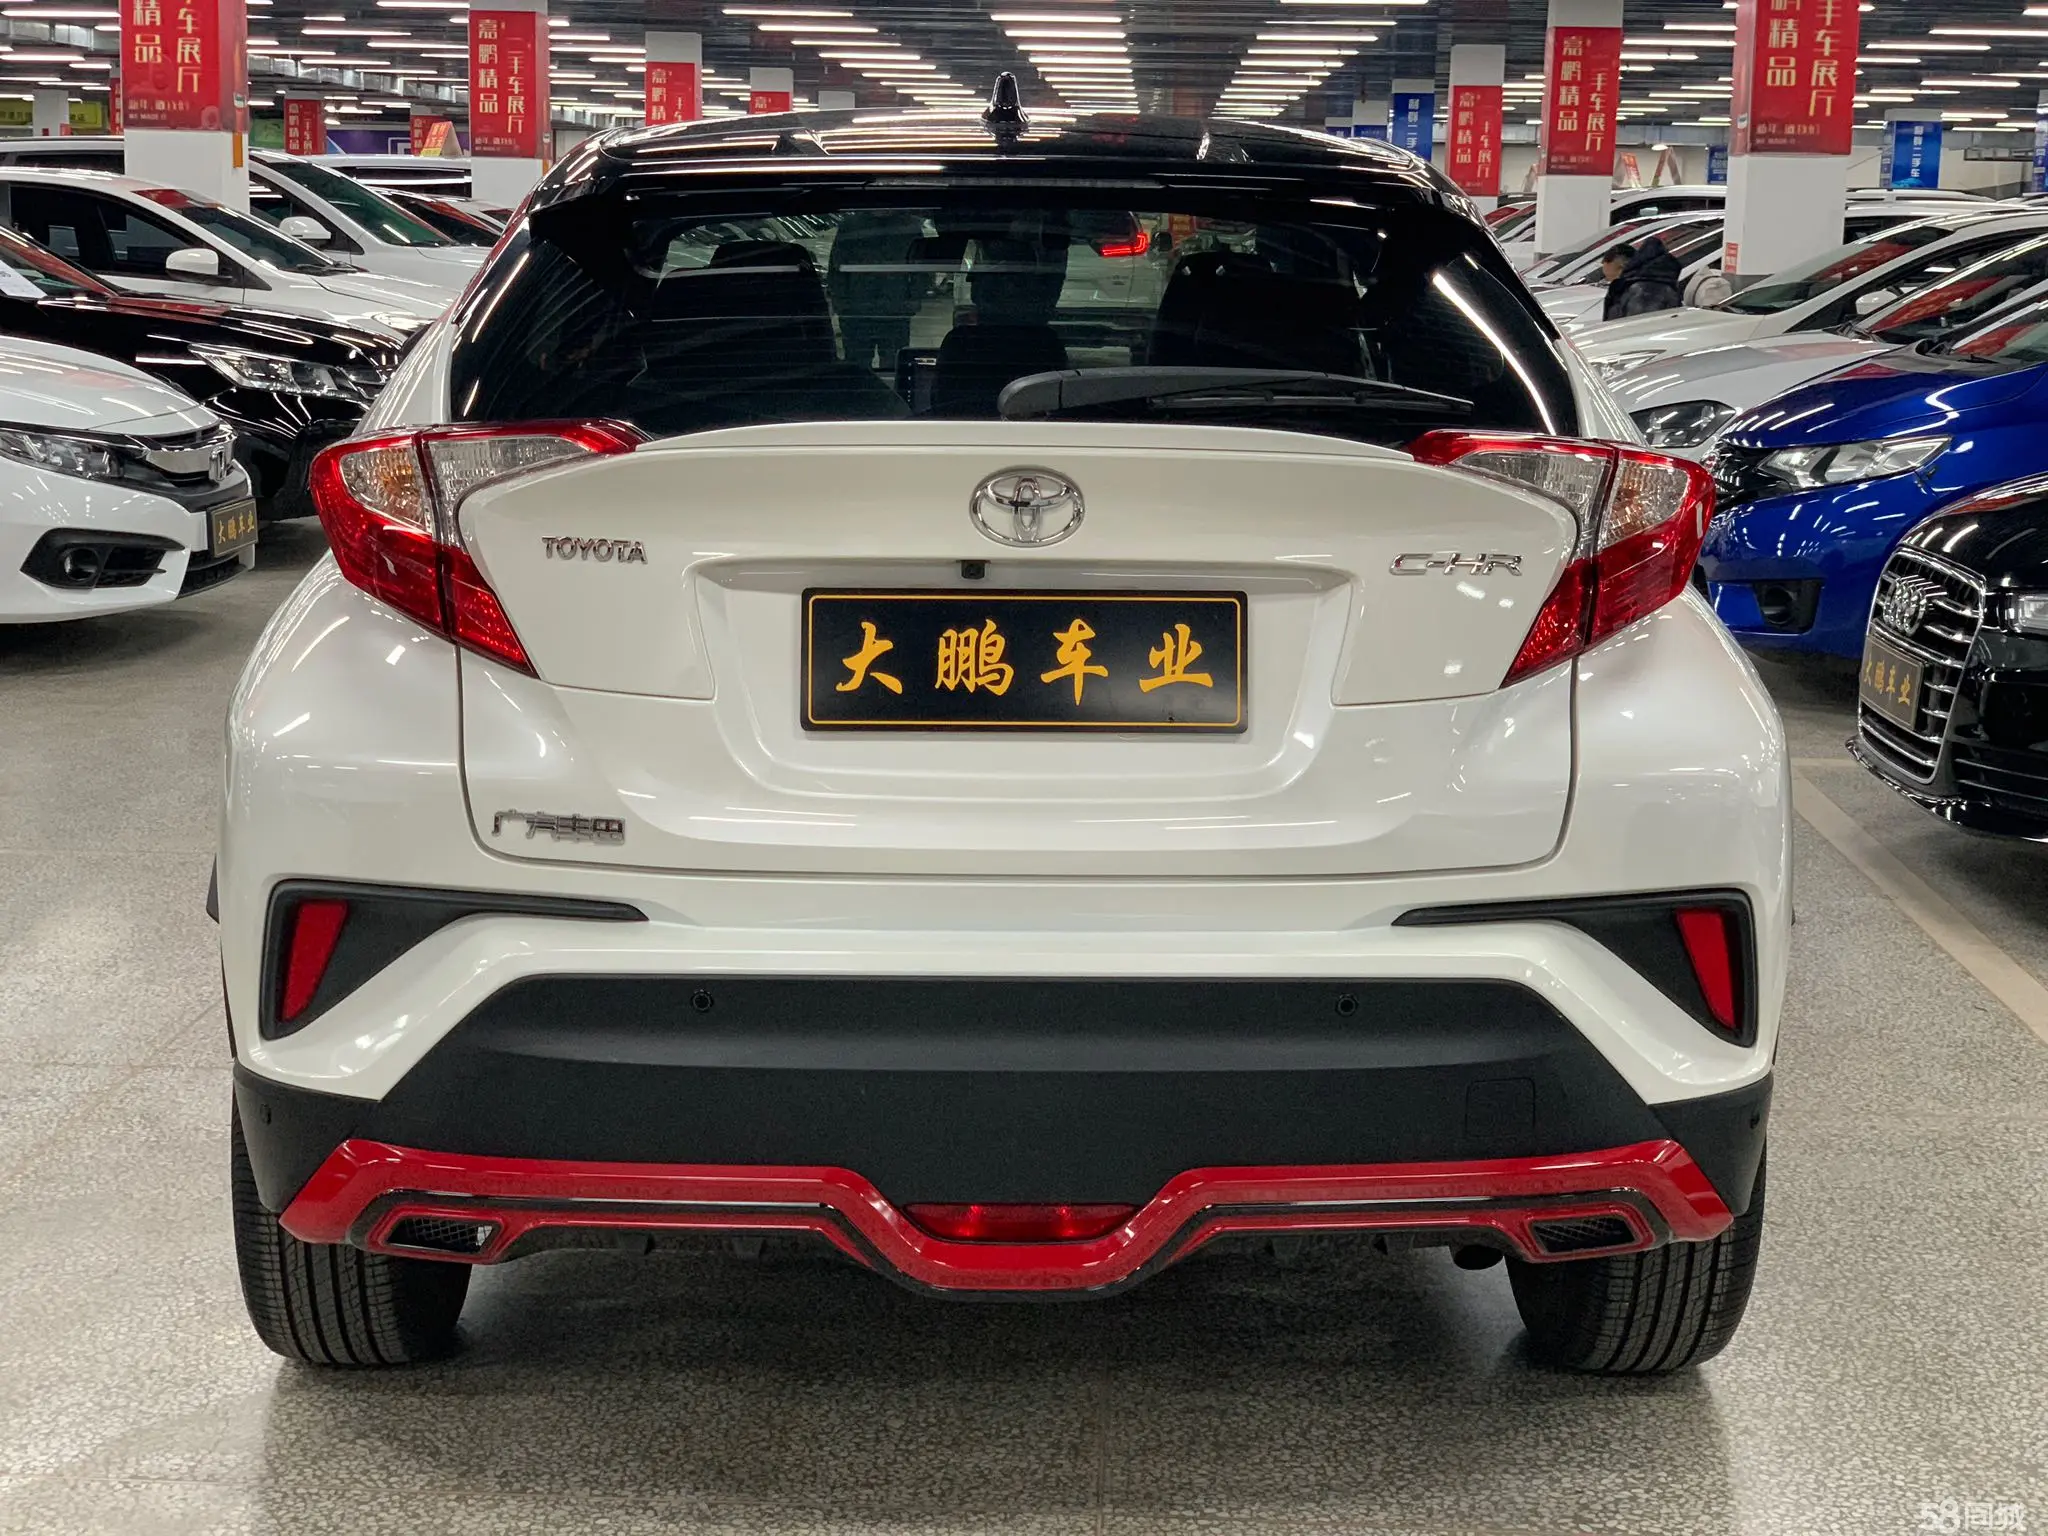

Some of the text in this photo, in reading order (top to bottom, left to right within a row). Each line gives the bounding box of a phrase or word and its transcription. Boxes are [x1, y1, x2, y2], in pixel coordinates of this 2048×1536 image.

[177, 0, 200, 93] 车展厅
[218, 510, 255, 545] 大鹏车业
[541, 536, 648, 565] TOYOTA
[1389, 553, 1523, 577] C-HR
[836, 618, 1213, 706] 大鹏车业
